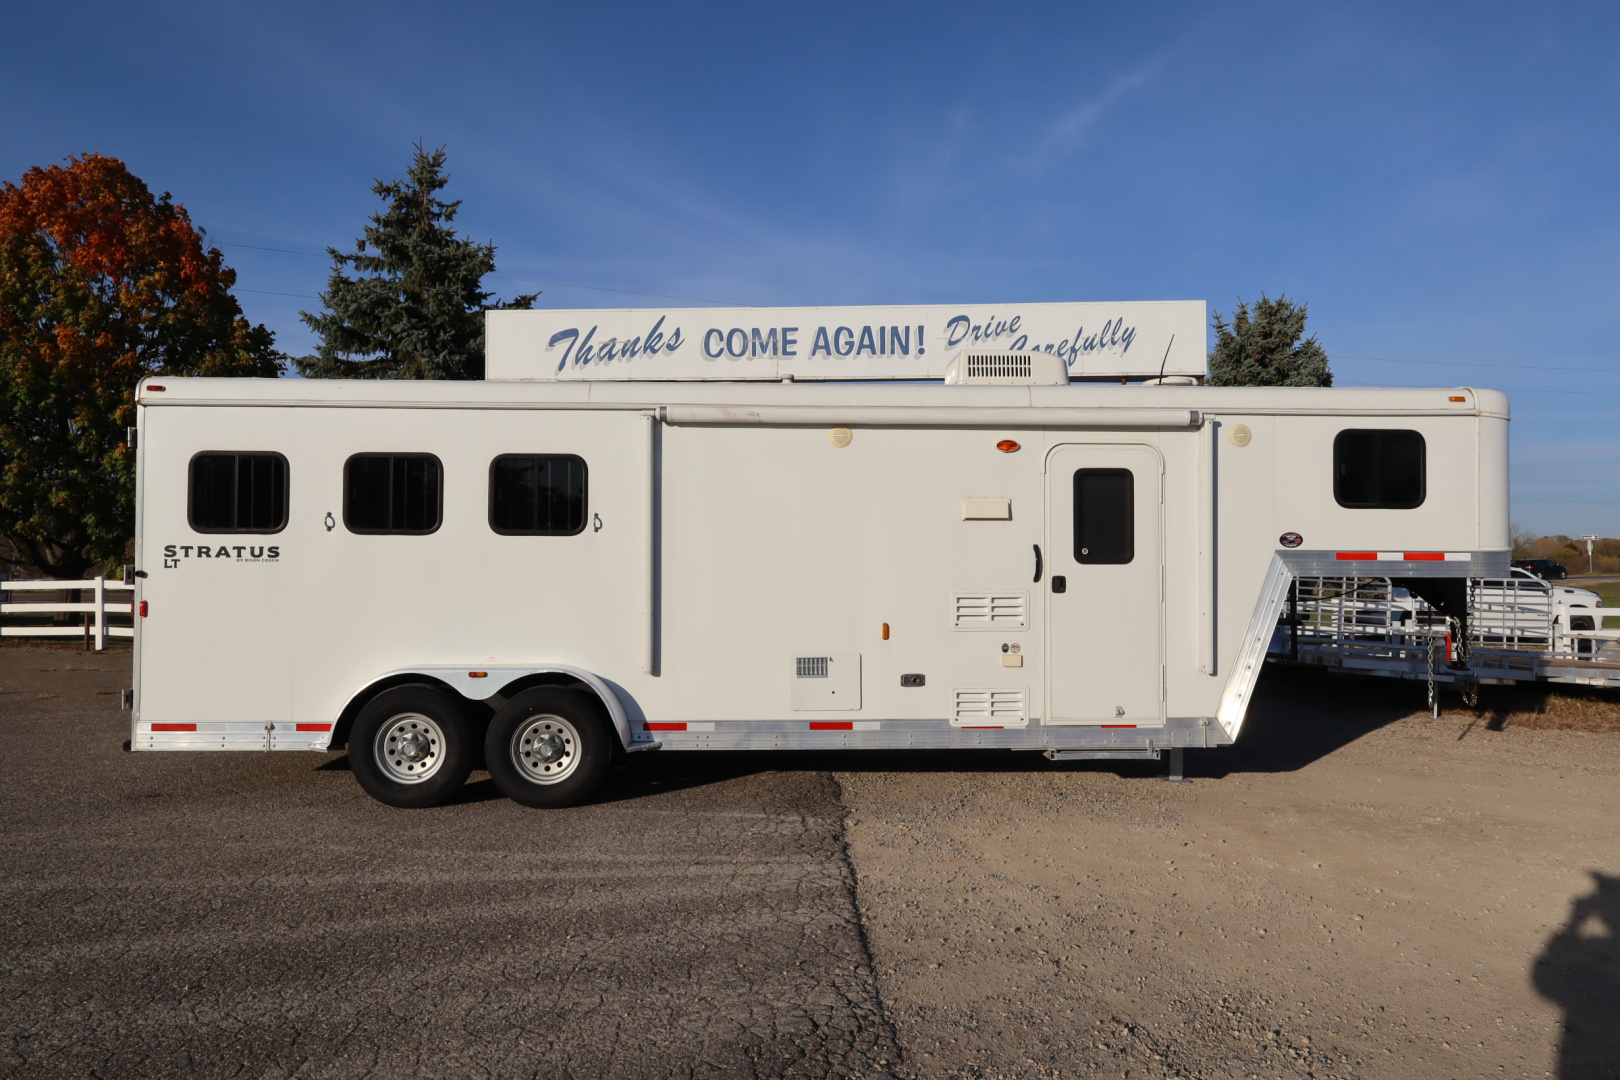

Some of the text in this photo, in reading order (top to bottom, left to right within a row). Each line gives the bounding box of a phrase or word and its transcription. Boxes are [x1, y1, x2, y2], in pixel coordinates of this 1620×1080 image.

[947, 315, 1021, 346] Drive
[549, 315, 926, 372] Thanks COME AGAIN!
[164, 545, 280, 558] STRATUS
[164, 559, 180, 569] LT
